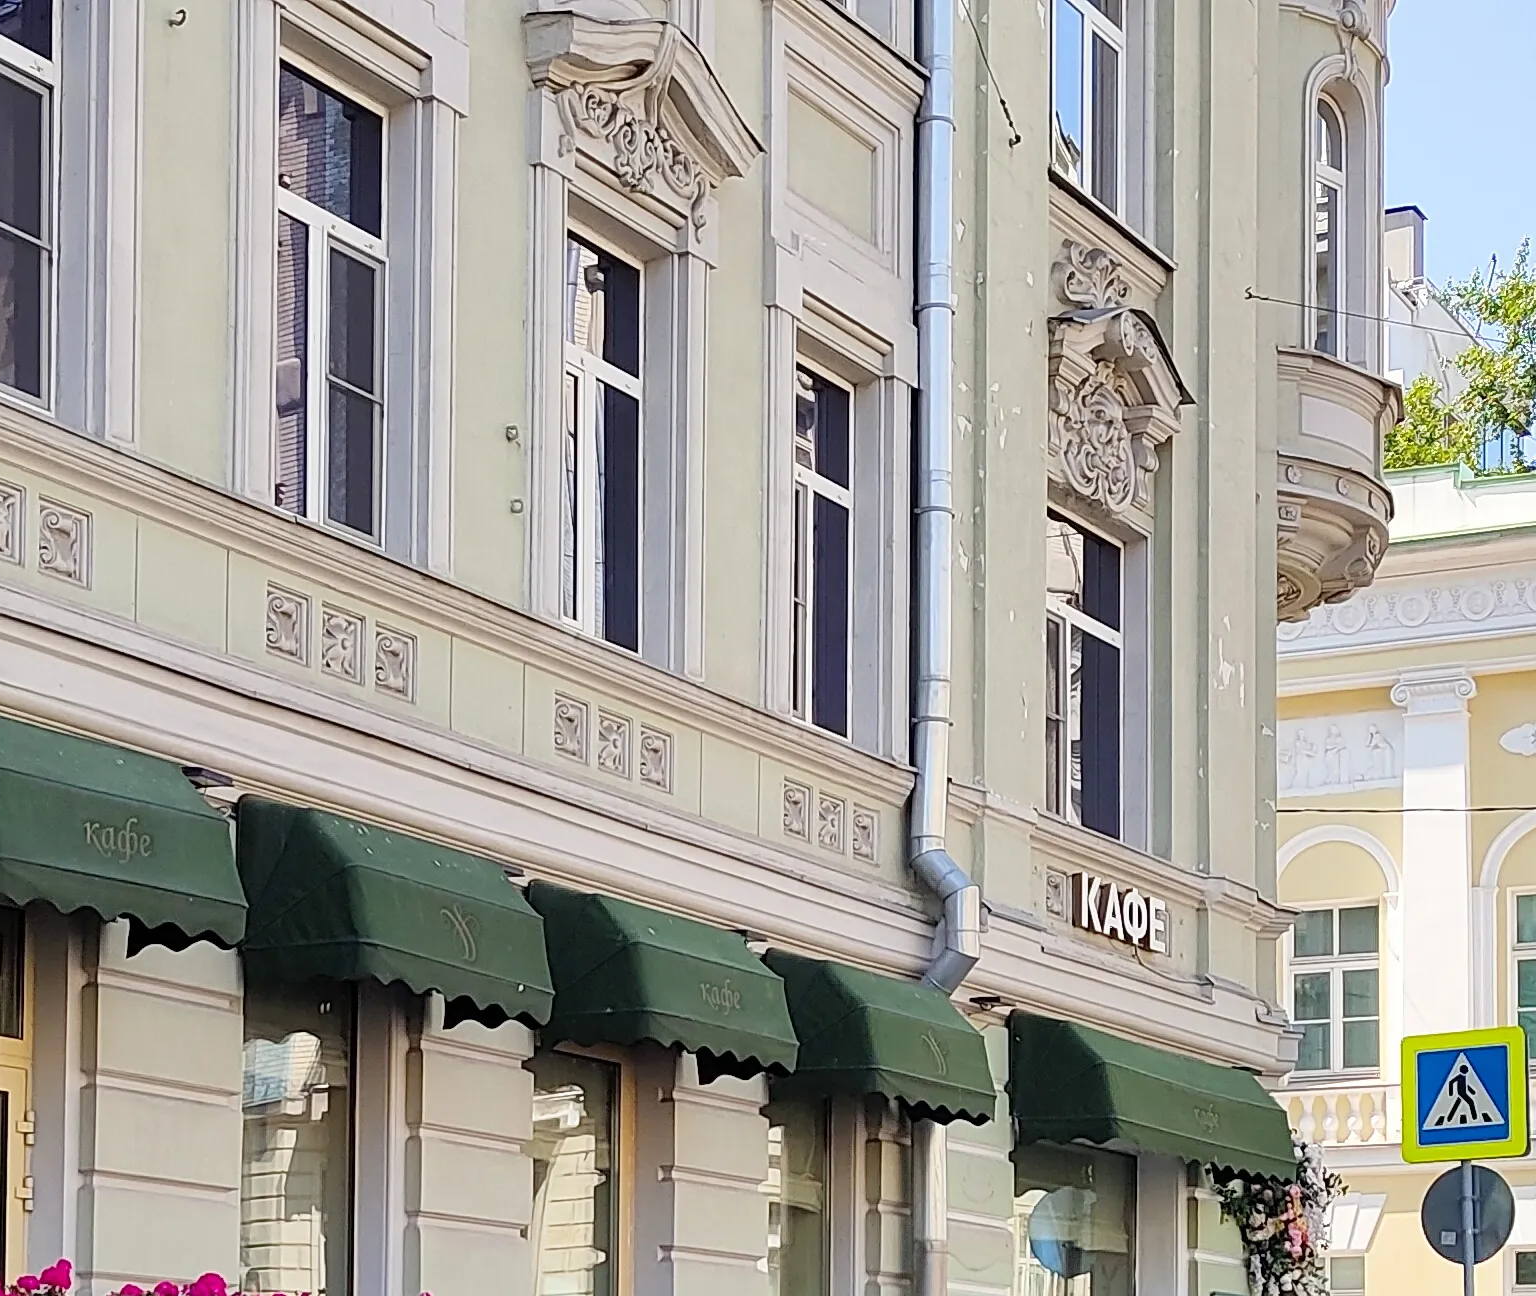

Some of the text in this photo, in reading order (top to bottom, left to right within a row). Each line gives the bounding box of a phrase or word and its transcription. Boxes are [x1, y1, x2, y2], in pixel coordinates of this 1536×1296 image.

[84, 817, 152, 864] кафе
[1080, 871, 1166, 954] КАФЕ
[700, 979, 741, 1016] кафе
